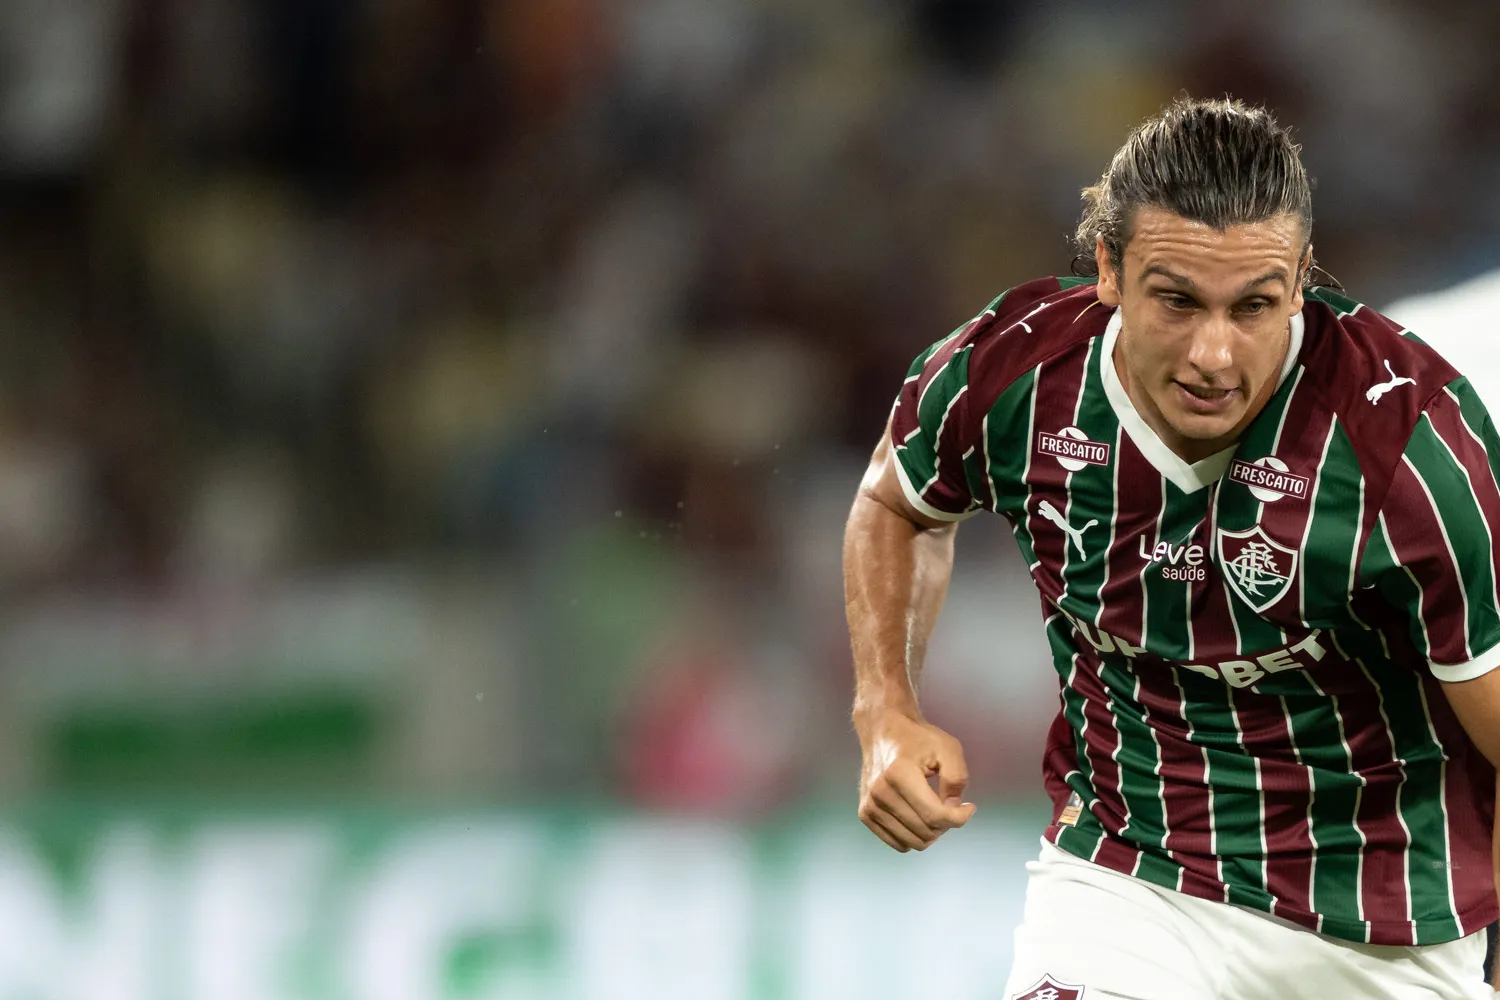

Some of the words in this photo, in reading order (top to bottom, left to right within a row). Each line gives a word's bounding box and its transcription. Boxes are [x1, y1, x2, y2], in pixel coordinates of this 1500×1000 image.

[1041, 437, 1105, 461] FRESCATTO
[1233, 465, 1304, 494] FRESCATTO
[1139, 534, 1204, 566] Leve
[1162, 565, 1206, 581] saúde
